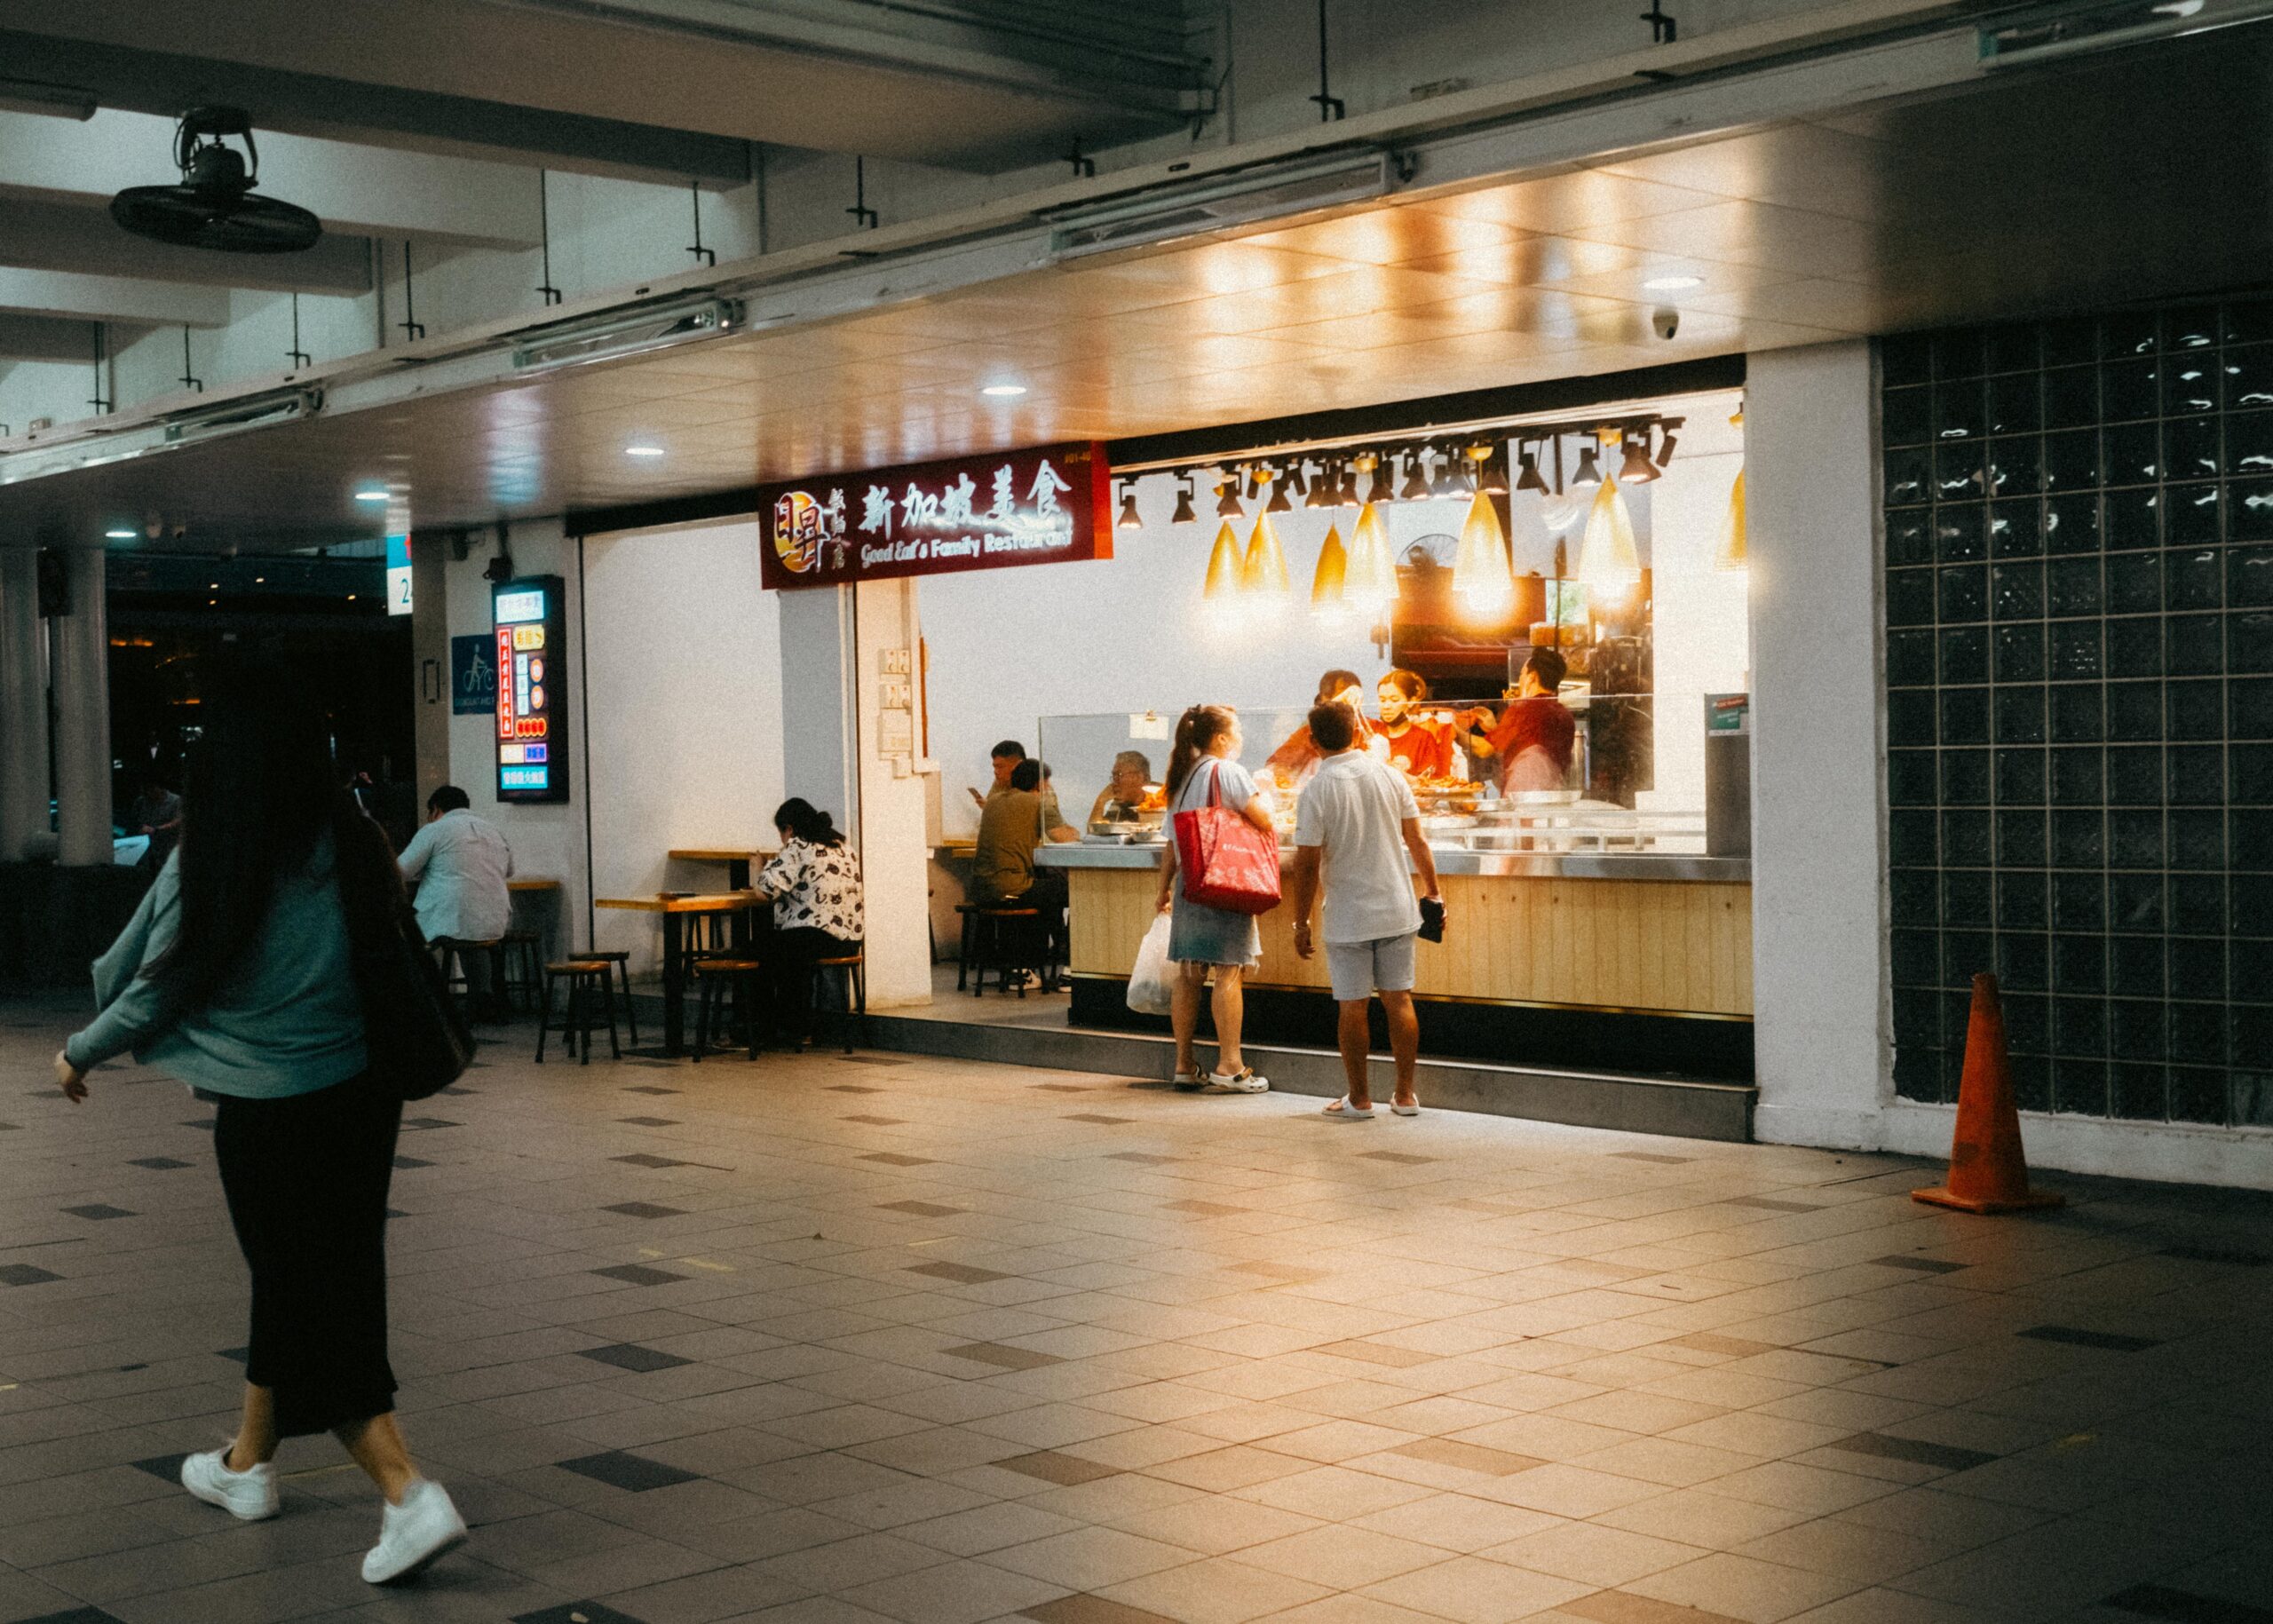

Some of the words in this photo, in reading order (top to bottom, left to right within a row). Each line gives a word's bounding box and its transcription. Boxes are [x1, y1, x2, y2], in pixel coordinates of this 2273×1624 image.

[858, 459, 1072, 539] 新加坡美食
[860, 543, 894, 569] Good
[931, 535, 981, 558] Family
[983, 529, 1073, 554] Restaurant
[400, 577, 413, 604] 2
